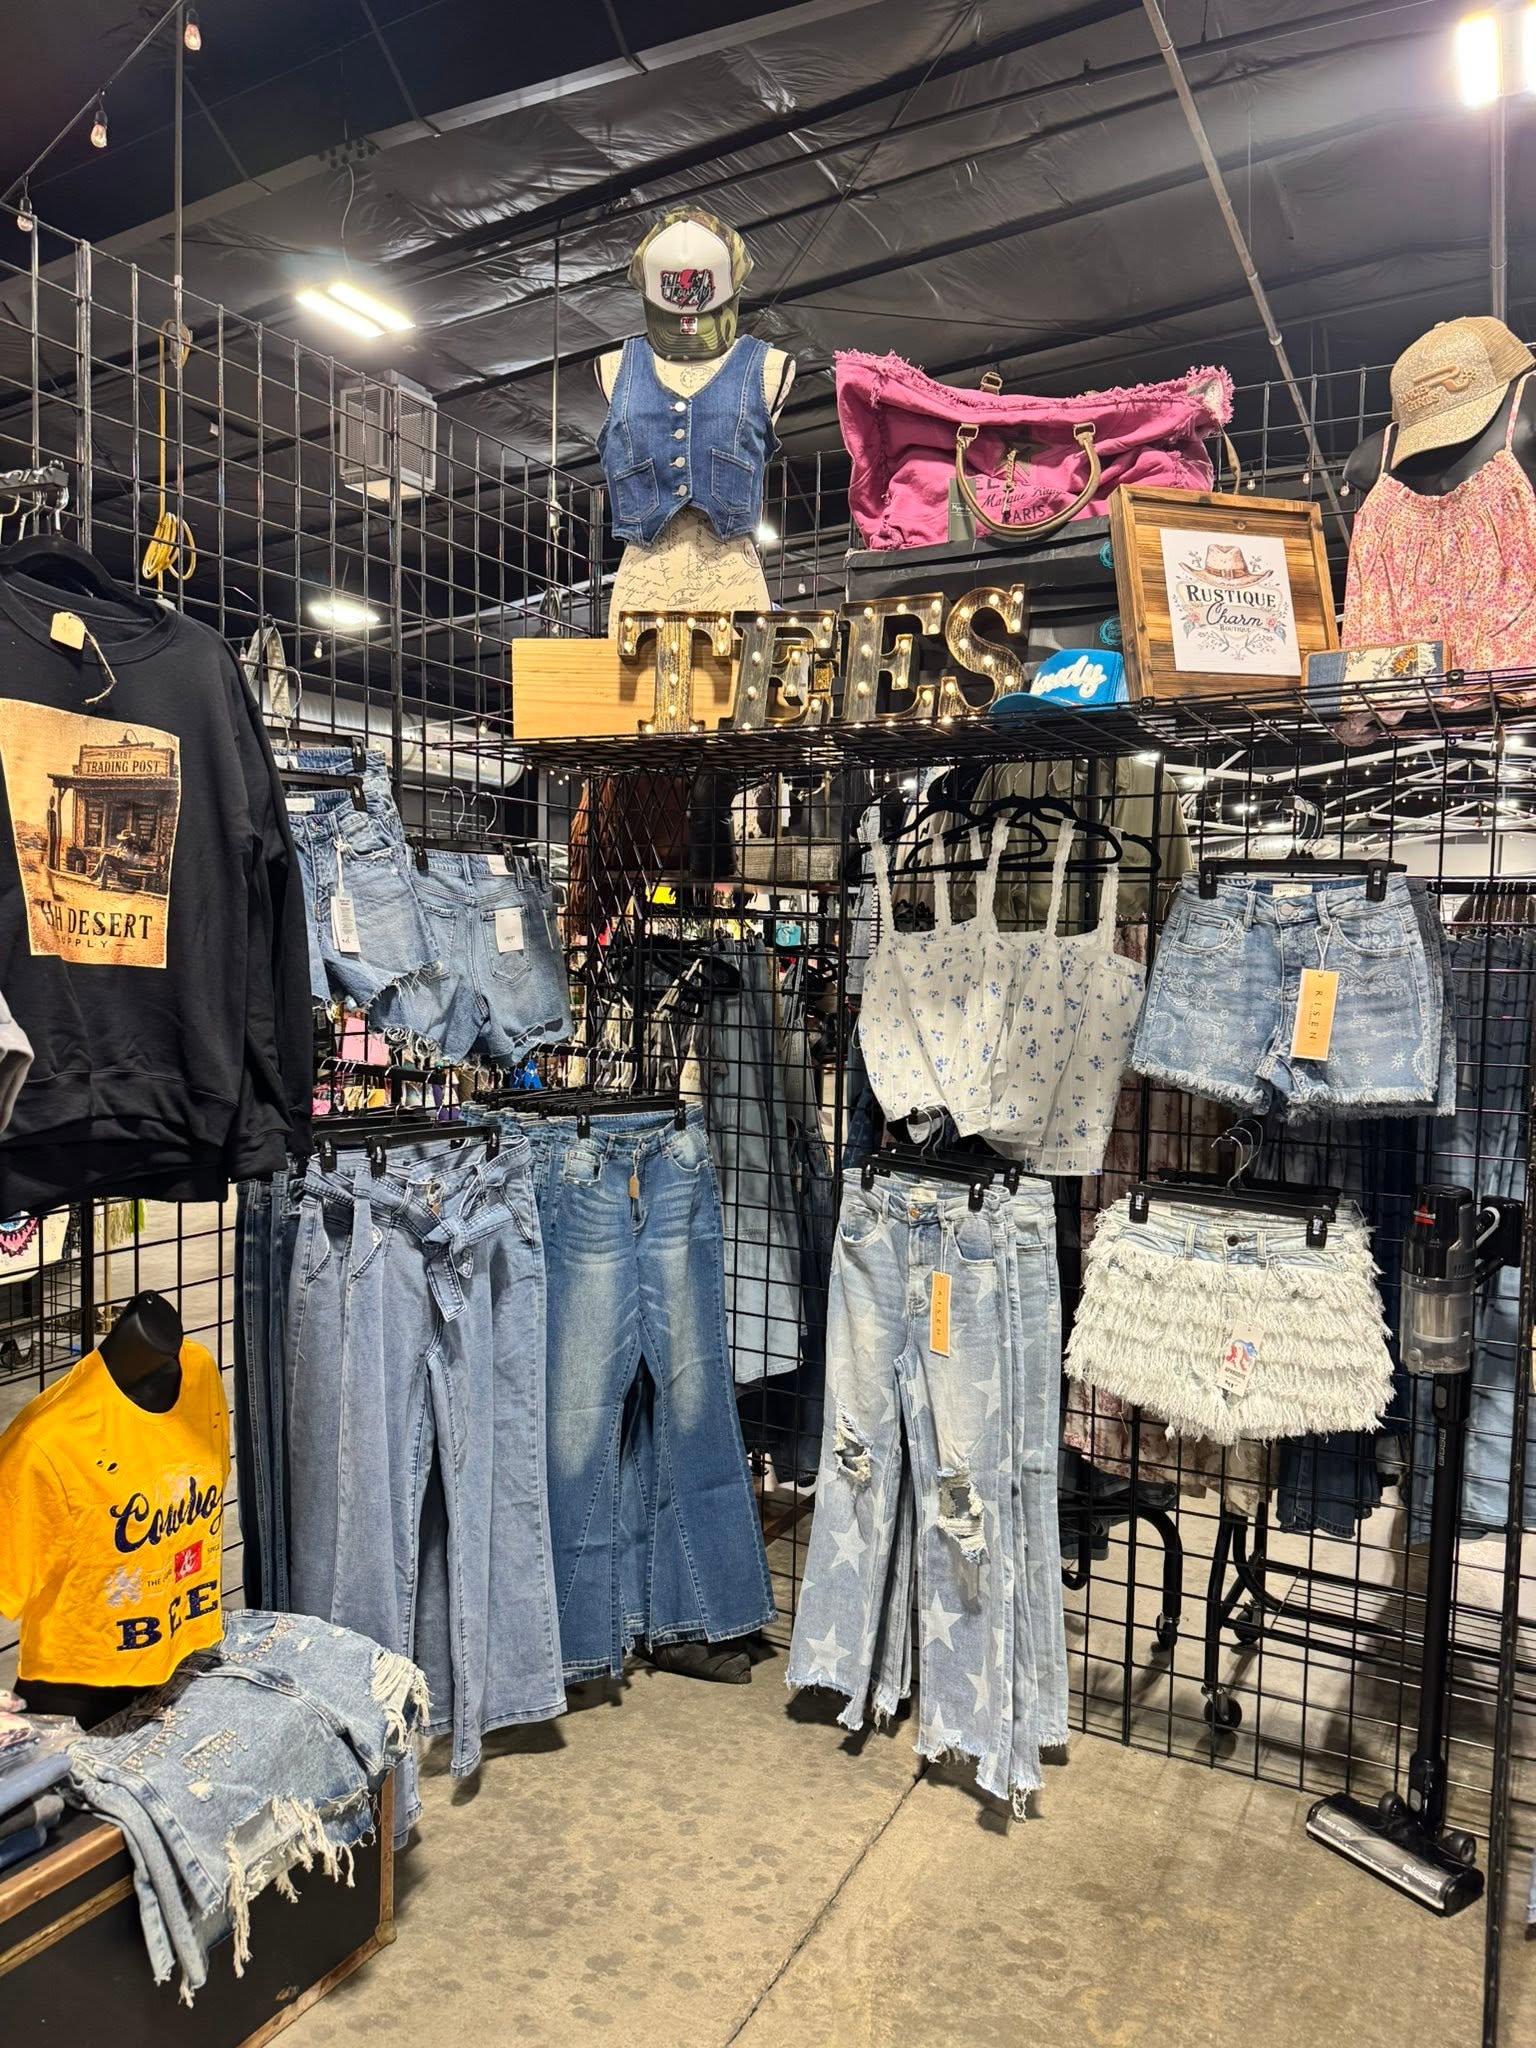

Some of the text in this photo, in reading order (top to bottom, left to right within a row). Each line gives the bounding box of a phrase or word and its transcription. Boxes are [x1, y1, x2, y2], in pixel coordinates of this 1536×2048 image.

[1186, 584, 1276, 608] RUSTIQUE
[1206, 600, 1263, 627] Charm
[617, 583, 1026, 736] TEES
[86, 760, 161, 773] TRADING POST
[67, 907, 153, 940] DESERT
[61, 935, 108, 948] UPPLY
[147, 1578, 161, 1588] THE
